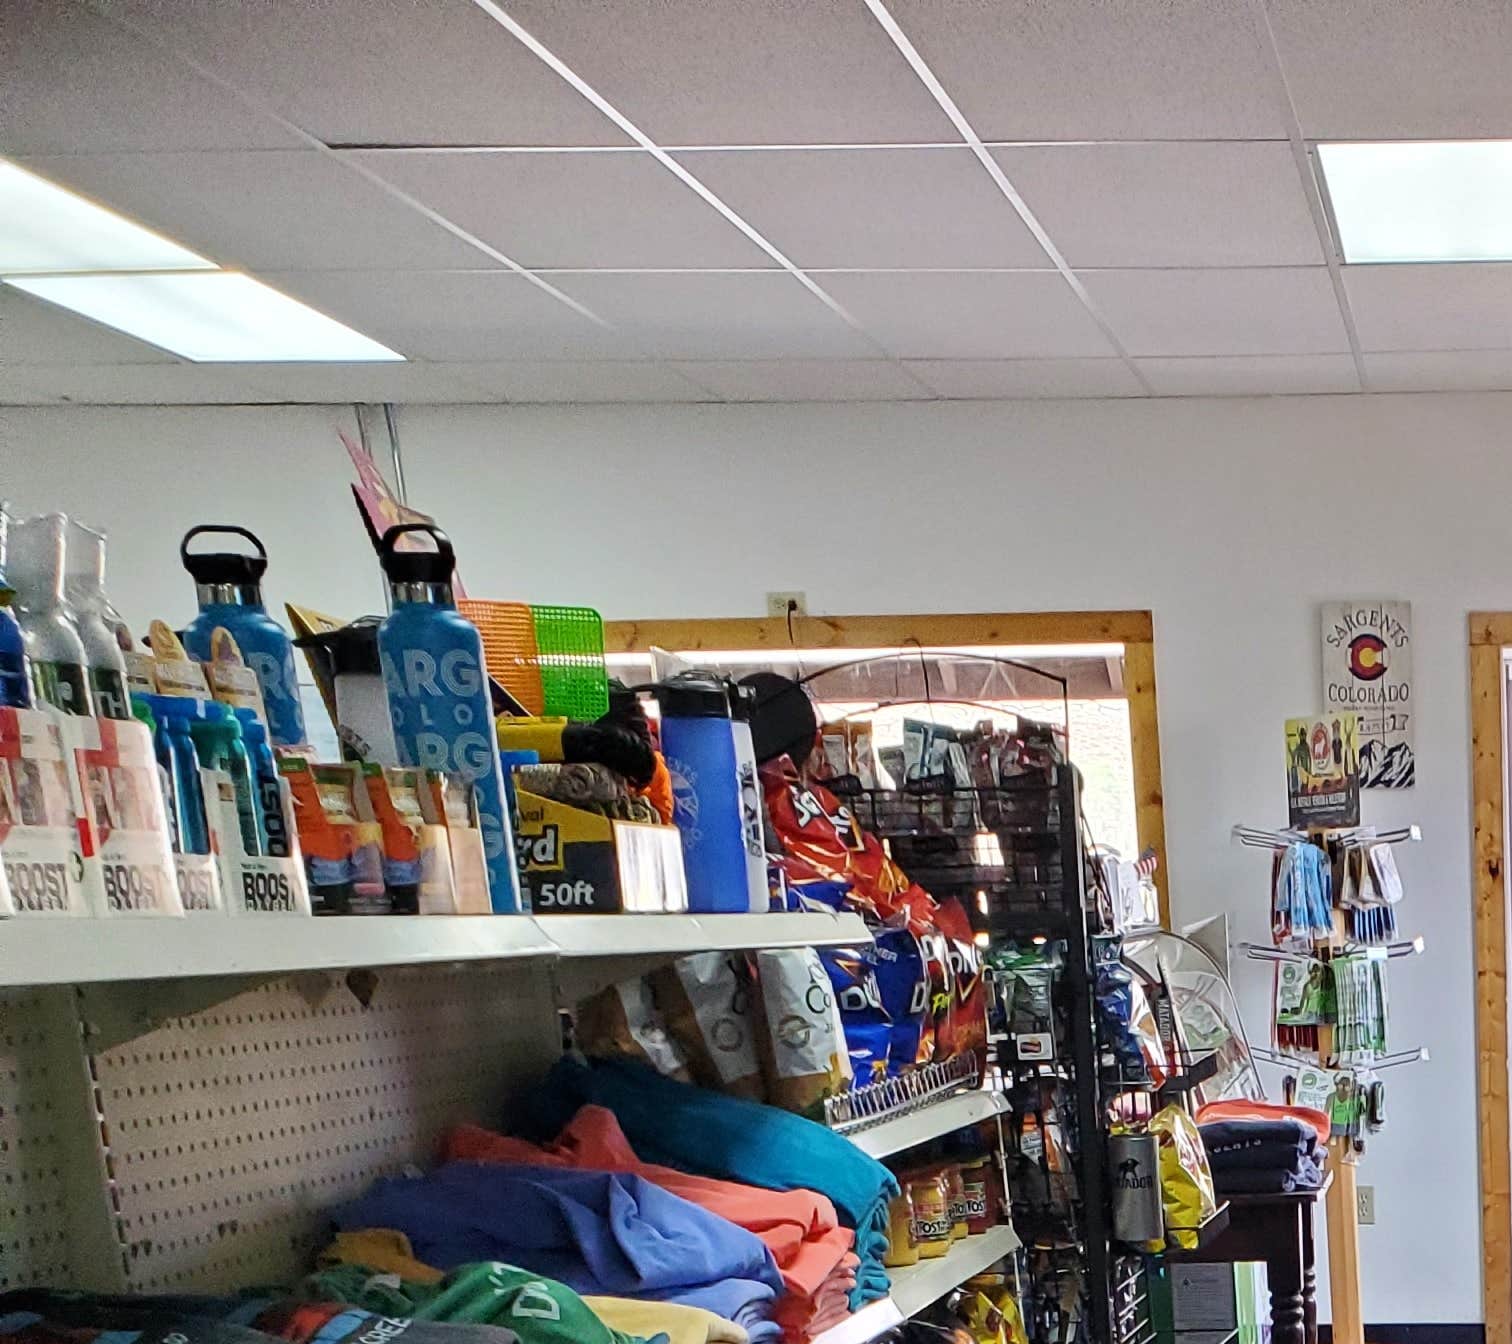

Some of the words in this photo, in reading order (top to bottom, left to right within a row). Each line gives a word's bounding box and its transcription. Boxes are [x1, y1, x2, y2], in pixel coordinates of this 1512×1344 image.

[1326, 609, 1409, 648] SARGENTS
[1328, 683, 1410, 704] COLORADO
[540, 880, 595, 908] 50ft
